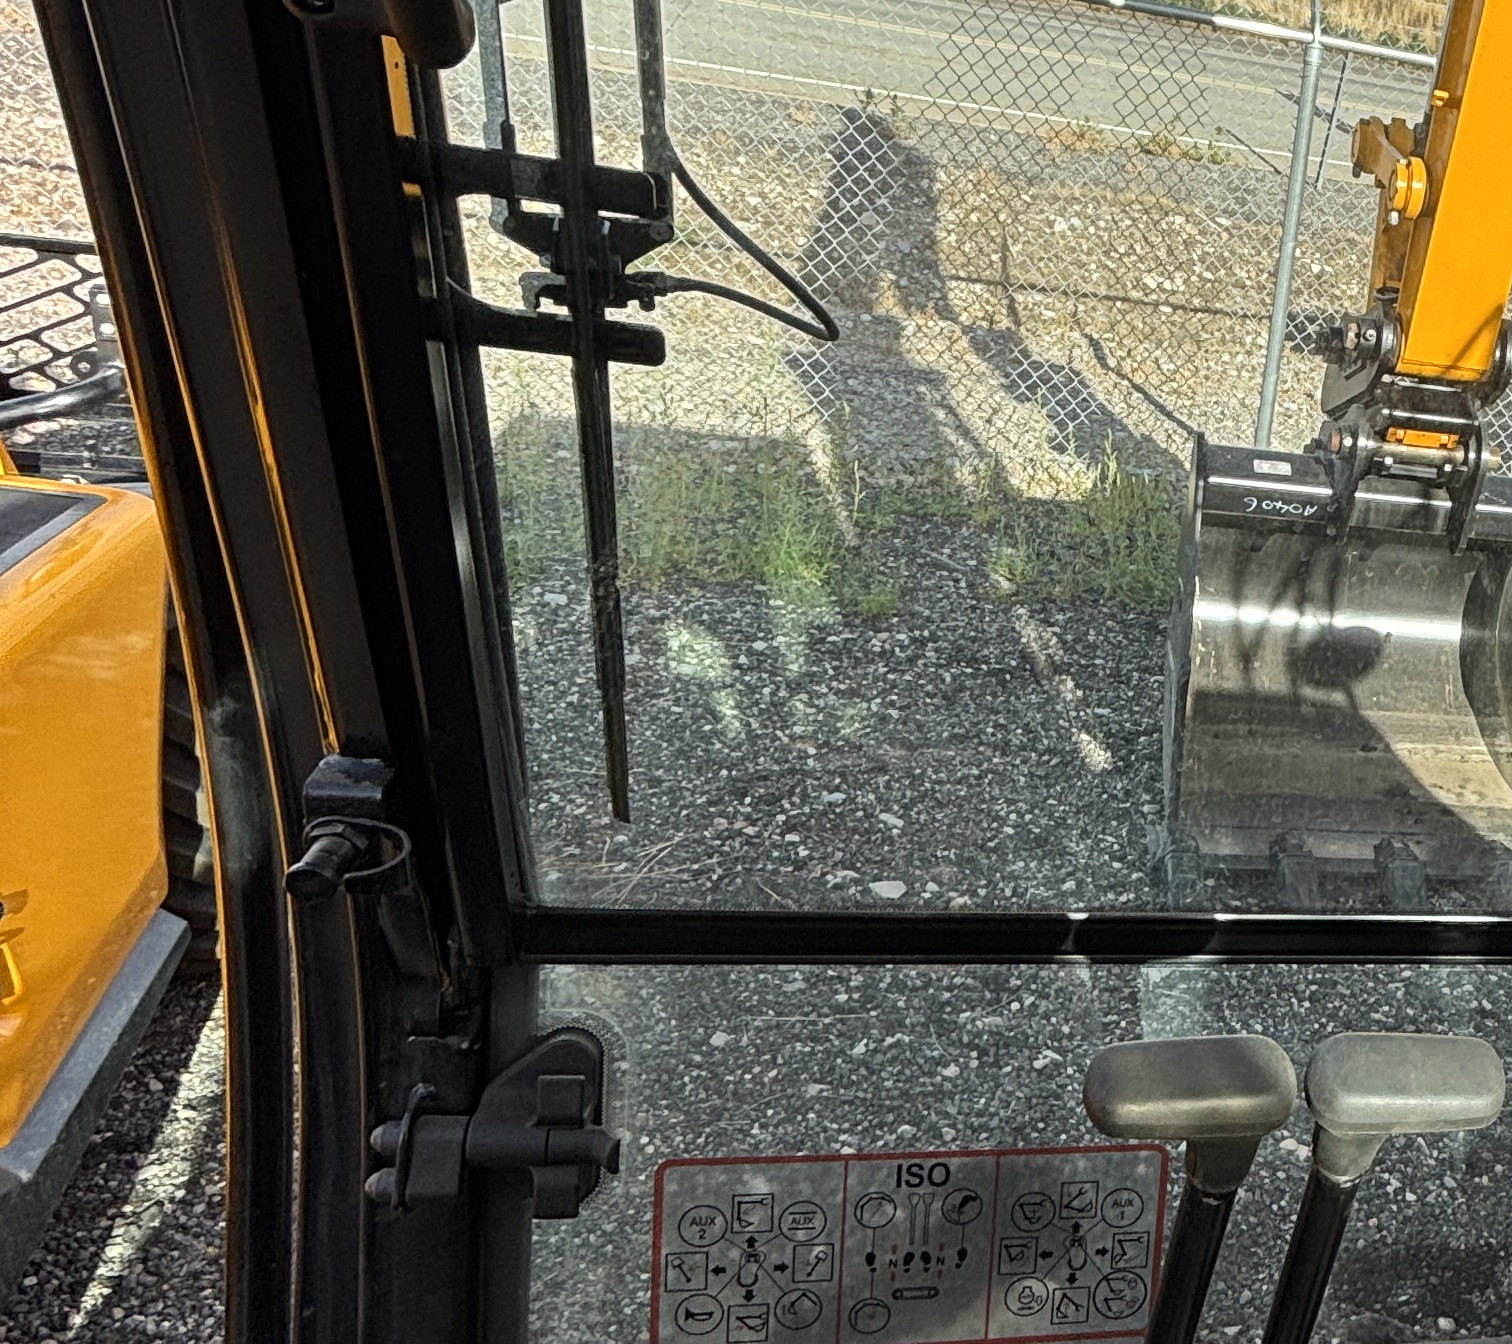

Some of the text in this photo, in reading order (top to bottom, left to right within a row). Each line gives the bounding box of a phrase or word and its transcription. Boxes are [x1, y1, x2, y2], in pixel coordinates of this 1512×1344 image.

[1243, 496, 1319, 516] A0406
[896, 1162, 951, 1188] ISO
[1111, 1198, 1134, 1209] AUX
[790, 1215, 815, 1226] AUX
[1120, 1210, 1125, 1221] 1
[689, 1216, 717, 1228] AUX
[698, 1229, 707, 1240] 2
[888, 1258, 898, 1268] N
[936, 1256, 945, 1266] N
